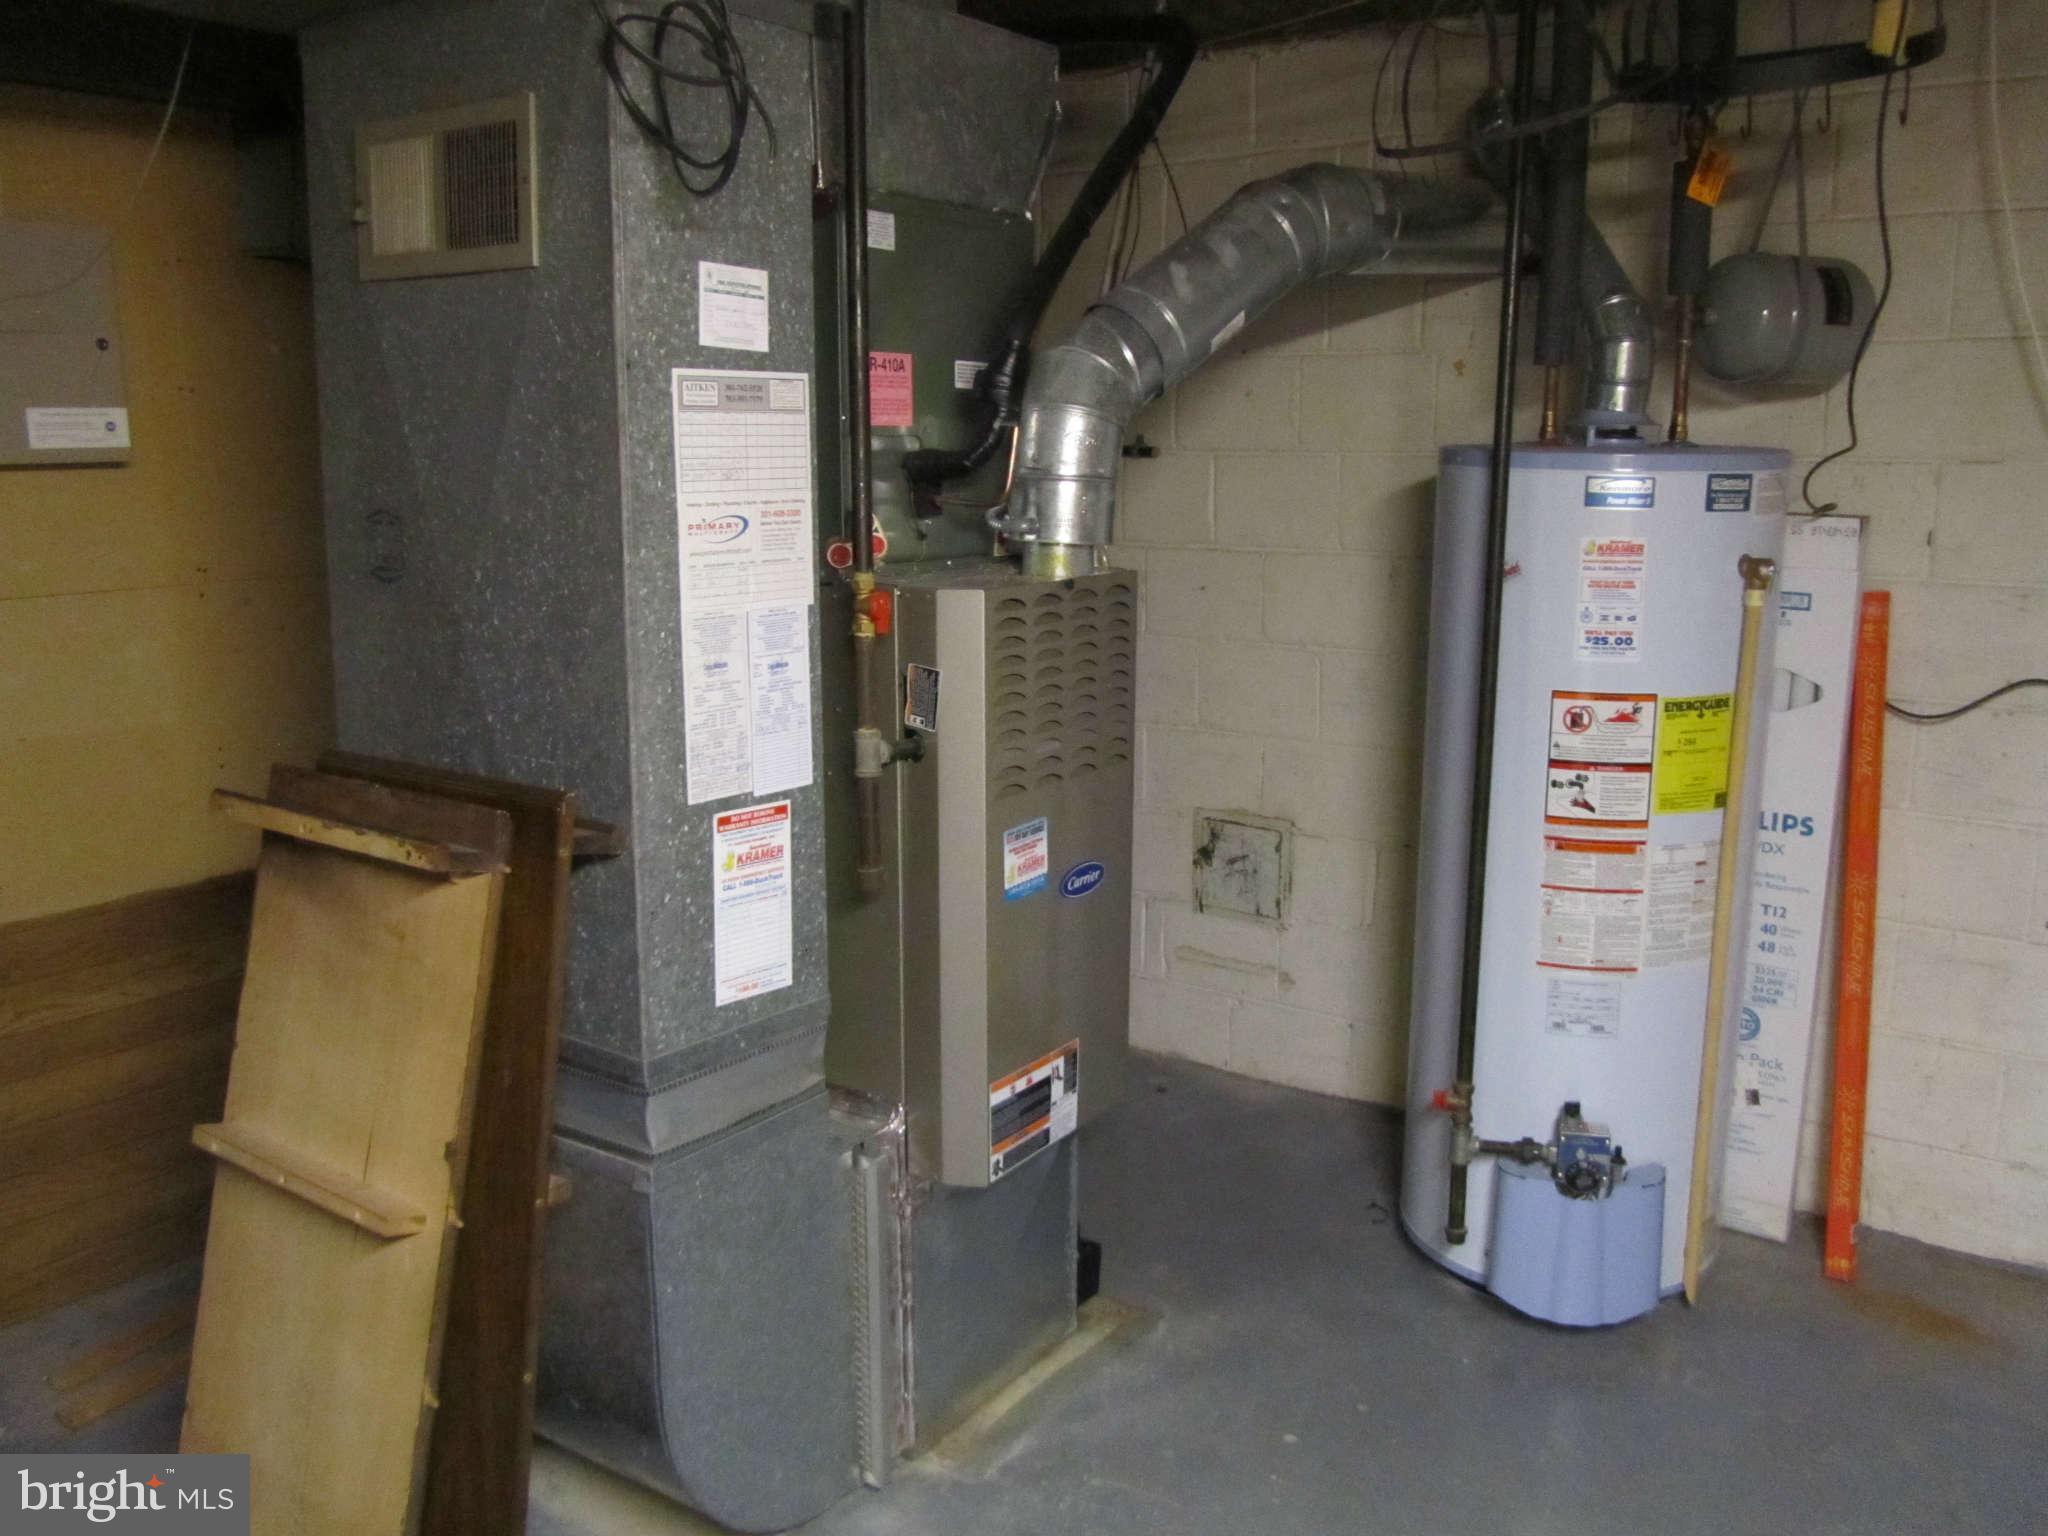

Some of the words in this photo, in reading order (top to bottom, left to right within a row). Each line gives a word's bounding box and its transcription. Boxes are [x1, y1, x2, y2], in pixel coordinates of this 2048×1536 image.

[870, 356, 905, 372] R-410A
[687, 521, 740, 531] PRIMARY
[1597, 544, 1645, 553] KRAMER
[1585, 636, 1634, 646] $25.00
[736, 845, 785, 866] KRAMER
[1067, 868, 1100, 891] Carrier
[1760, 904, 1787, 919] T12
[1759, 923, 1777, 936] 40
[1757, 941, 1776, 954] 48
